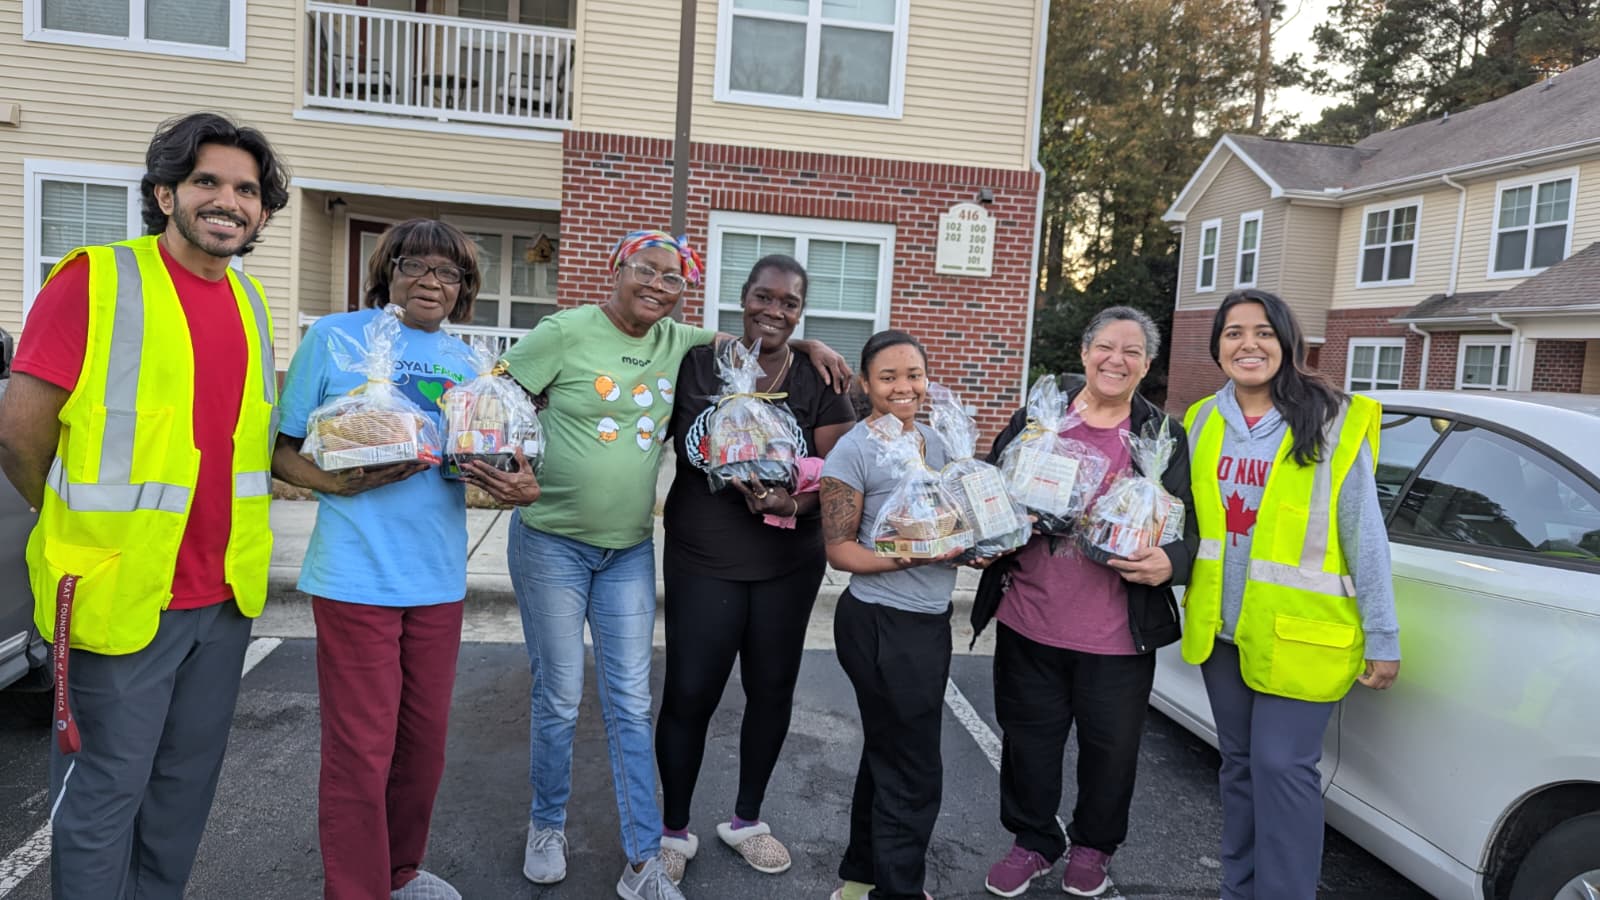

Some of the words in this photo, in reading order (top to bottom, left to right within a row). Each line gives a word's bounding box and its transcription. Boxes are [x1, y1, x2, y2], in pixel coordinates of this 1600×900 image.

[959, 209, 979, 221] 416
[946, 222, 961, 231] 102
[970, 224, 987, 233] 100
[945, 233, 961, 242] 202
[968, 245, 984, 254] 201
[967, 256, 981, 265] 101
[1234, 458, 1273, 487] NAV
[58, 603, 69, 659] FOUNDATION
